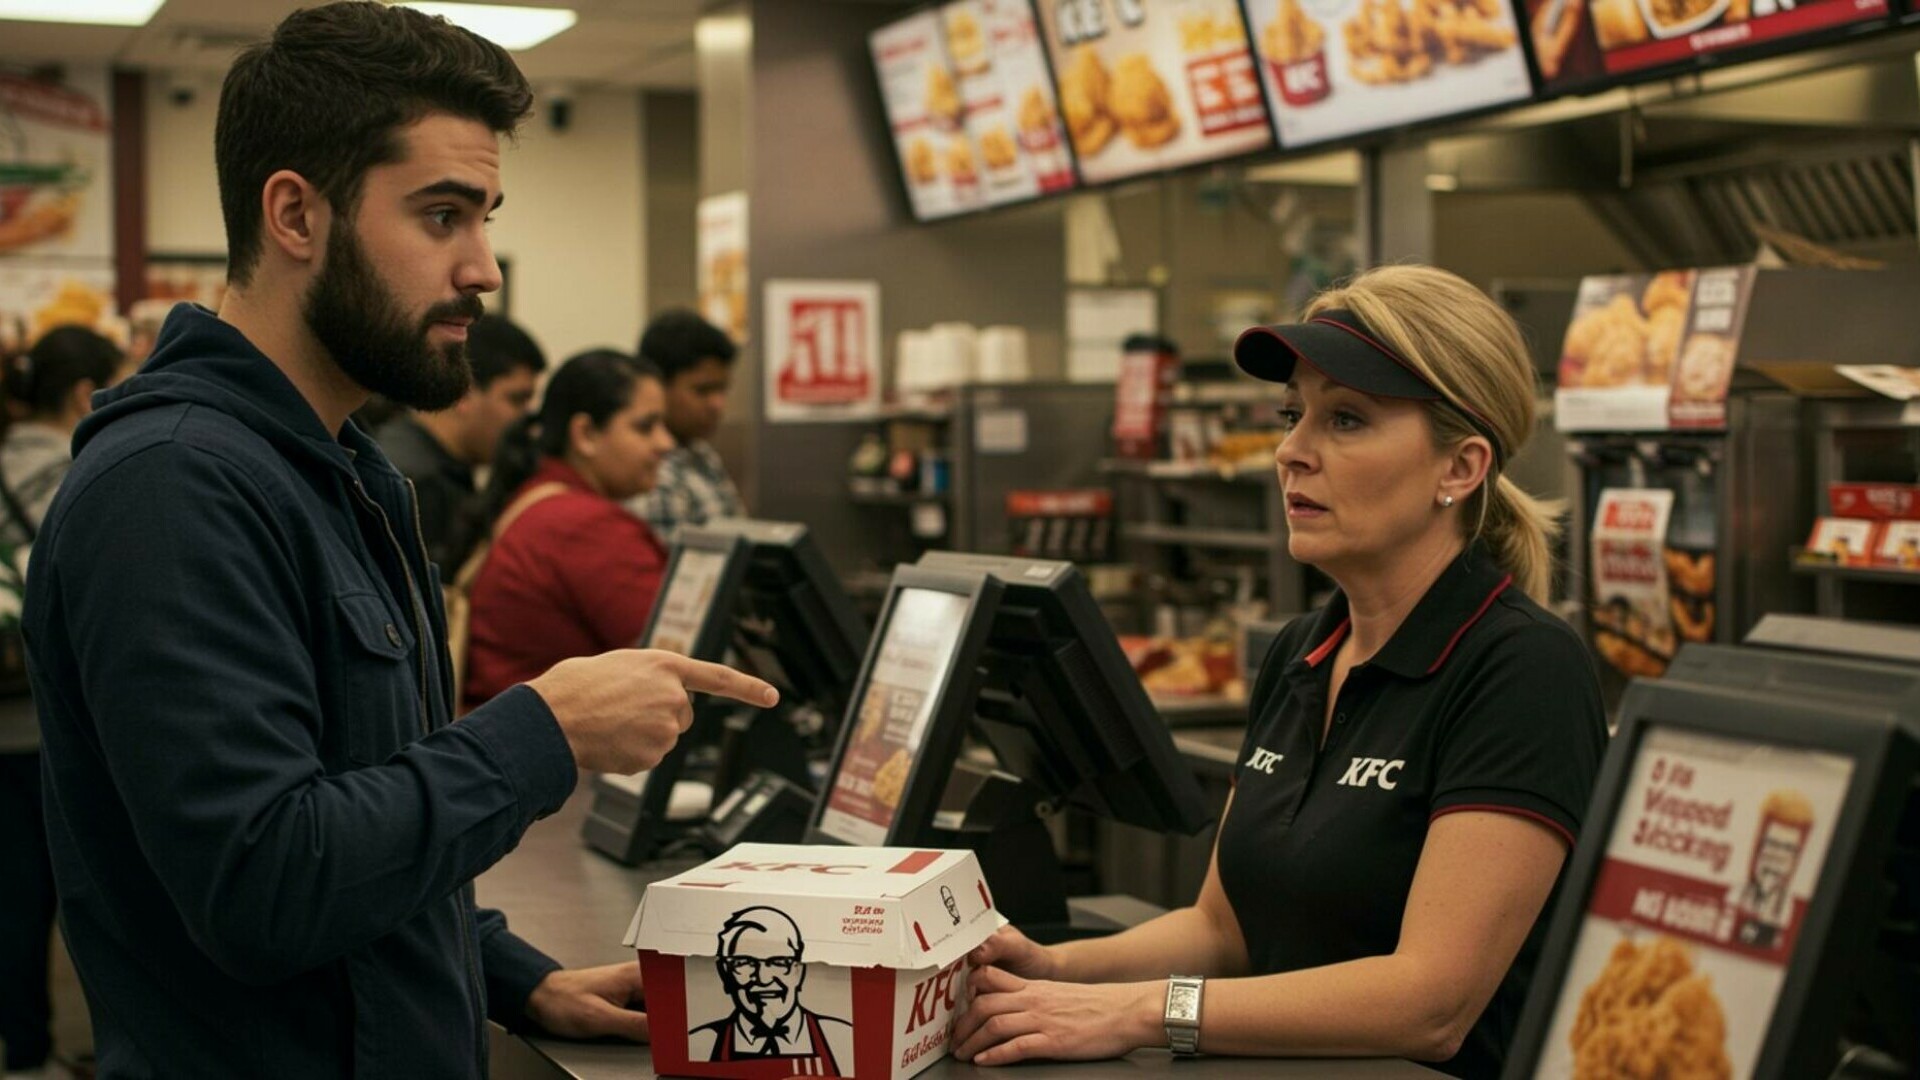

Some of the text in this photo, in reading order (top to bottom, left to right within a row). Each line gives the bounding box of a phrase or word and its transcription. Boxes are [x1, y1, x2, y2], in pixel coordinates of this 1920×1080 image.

[1245, 747, 1284, 774] KFC
[1337, 757, 1406, 790] KFC
[712, 861, 868, 876] KFC
[905, 960, 963, 1035] KFC
